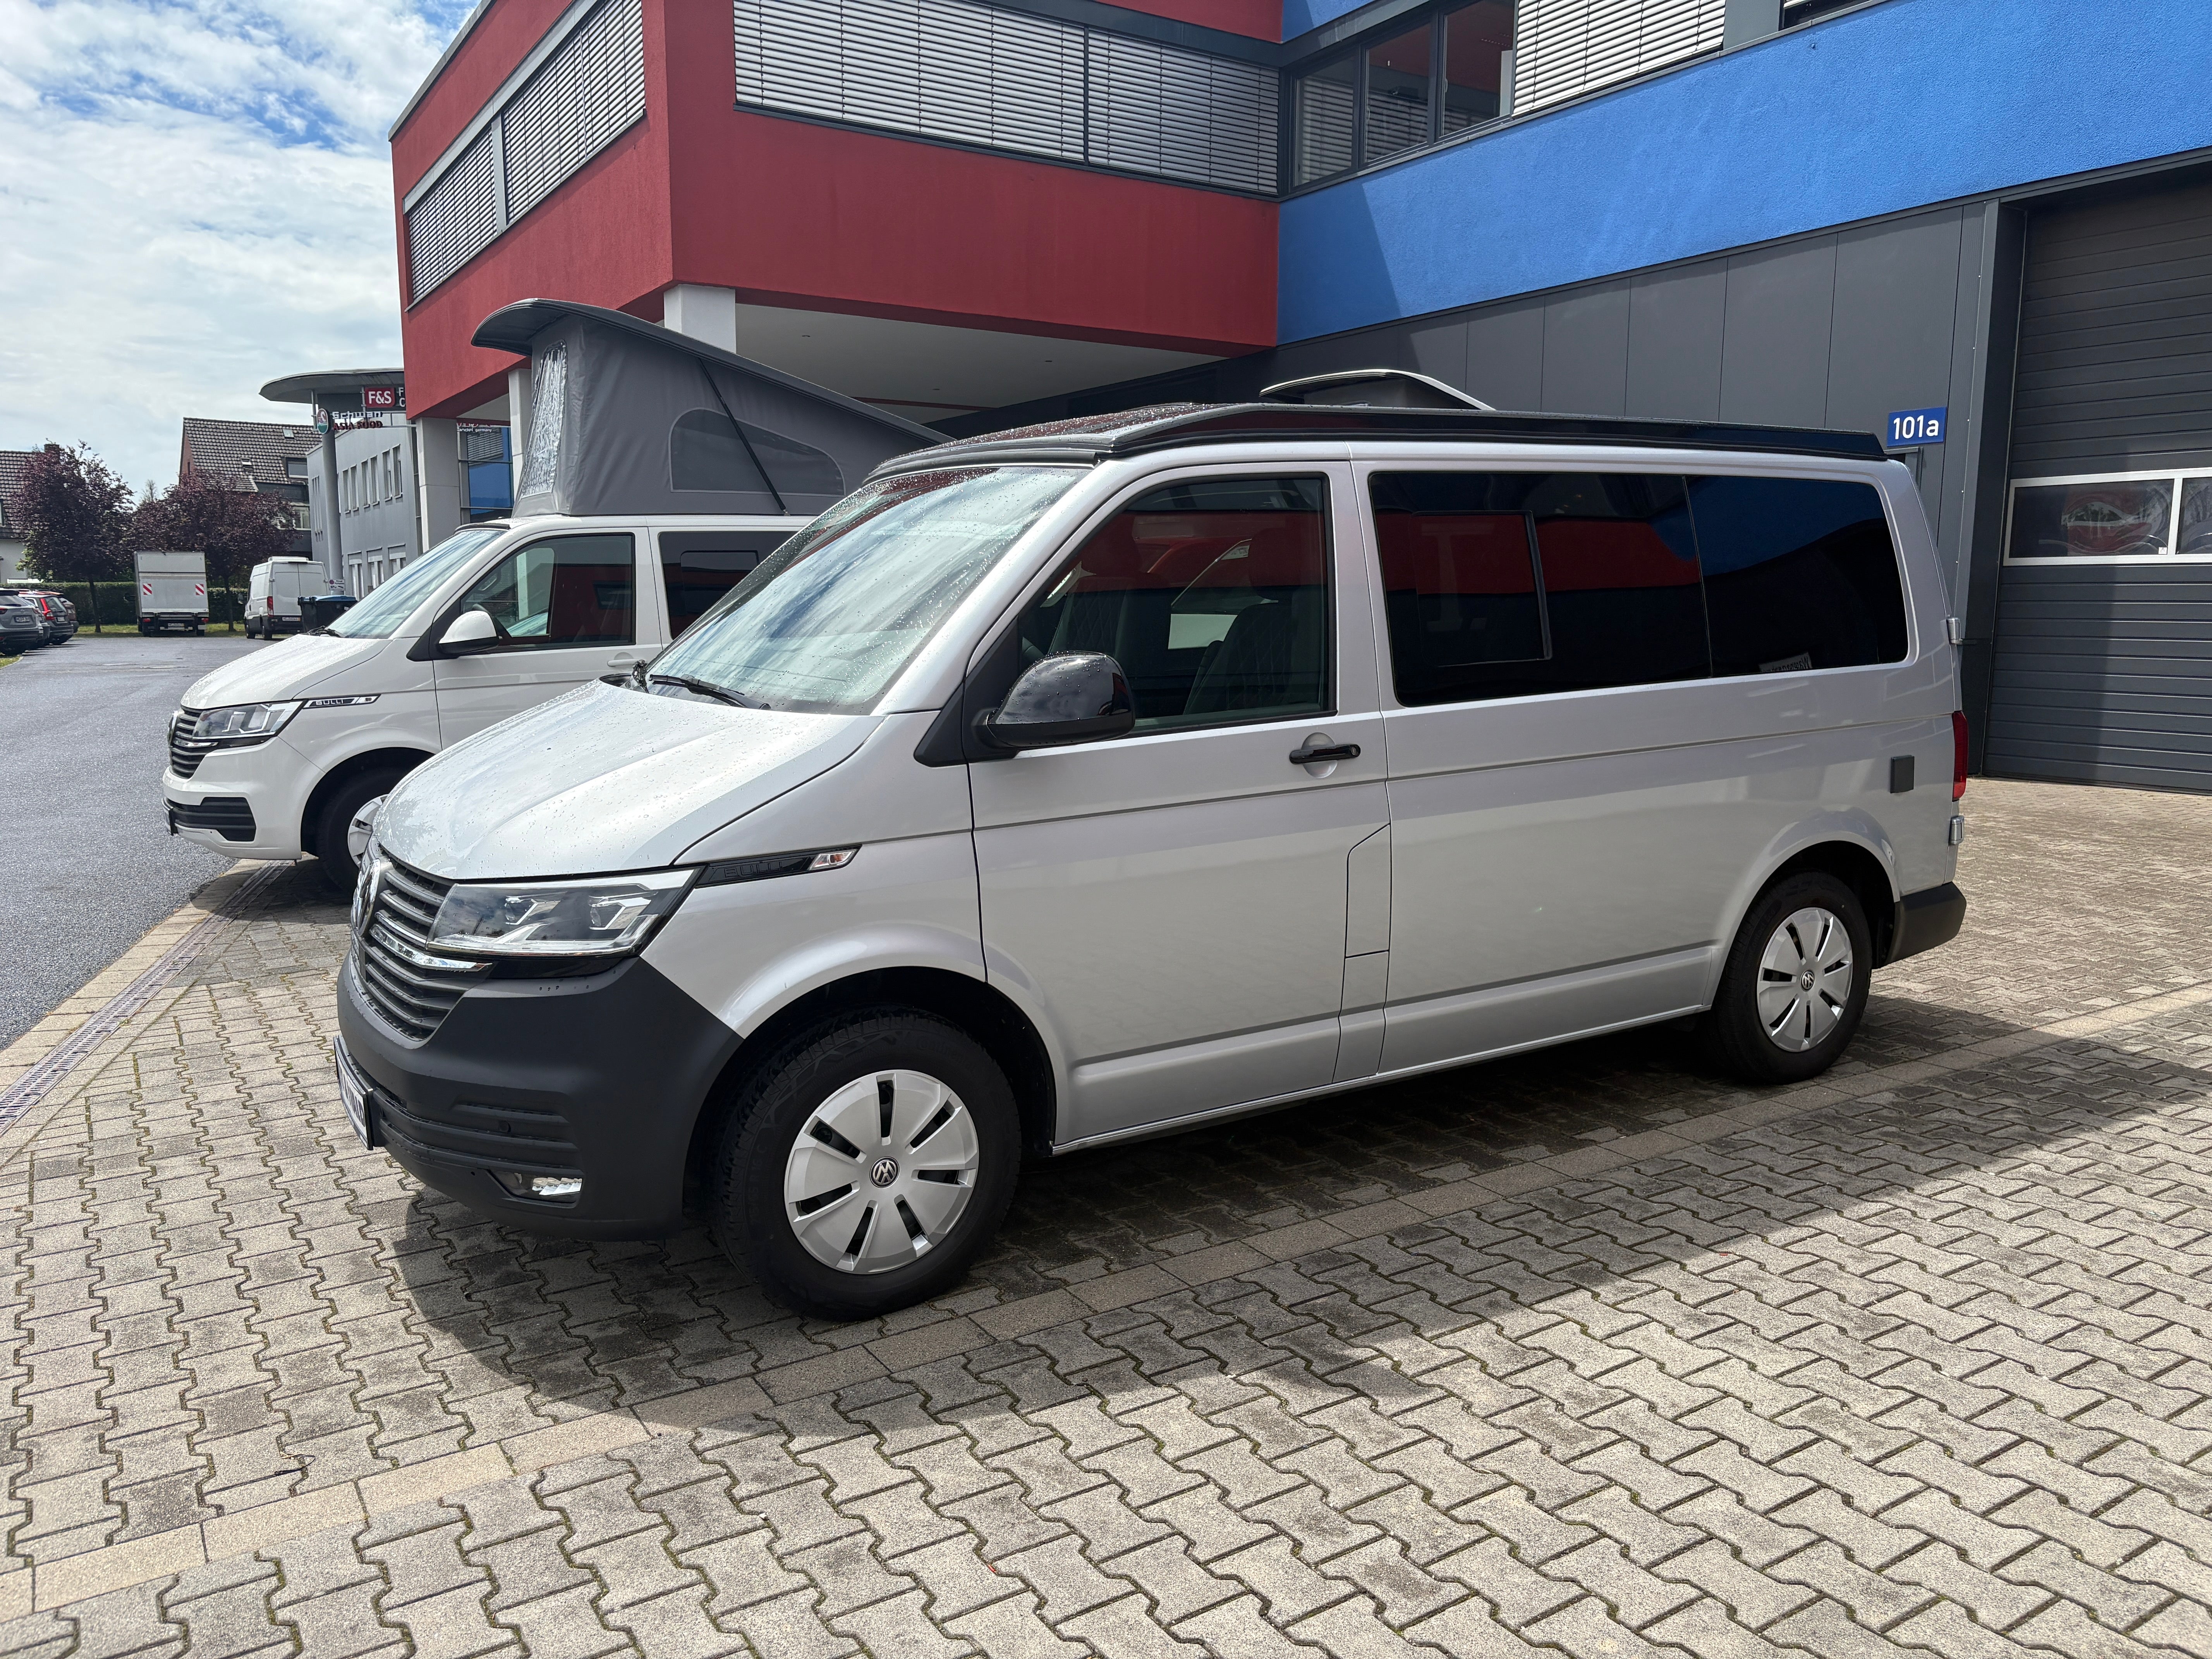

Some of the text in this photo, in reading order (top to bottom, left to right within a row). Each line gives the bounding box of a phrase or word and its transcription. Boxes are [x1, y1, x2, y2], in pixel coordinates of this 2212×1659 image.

[368, 391, 392, 404] F&S
[1893, 415, 1939, 440] 101a
[724, 861, 782, 878] BULLI
